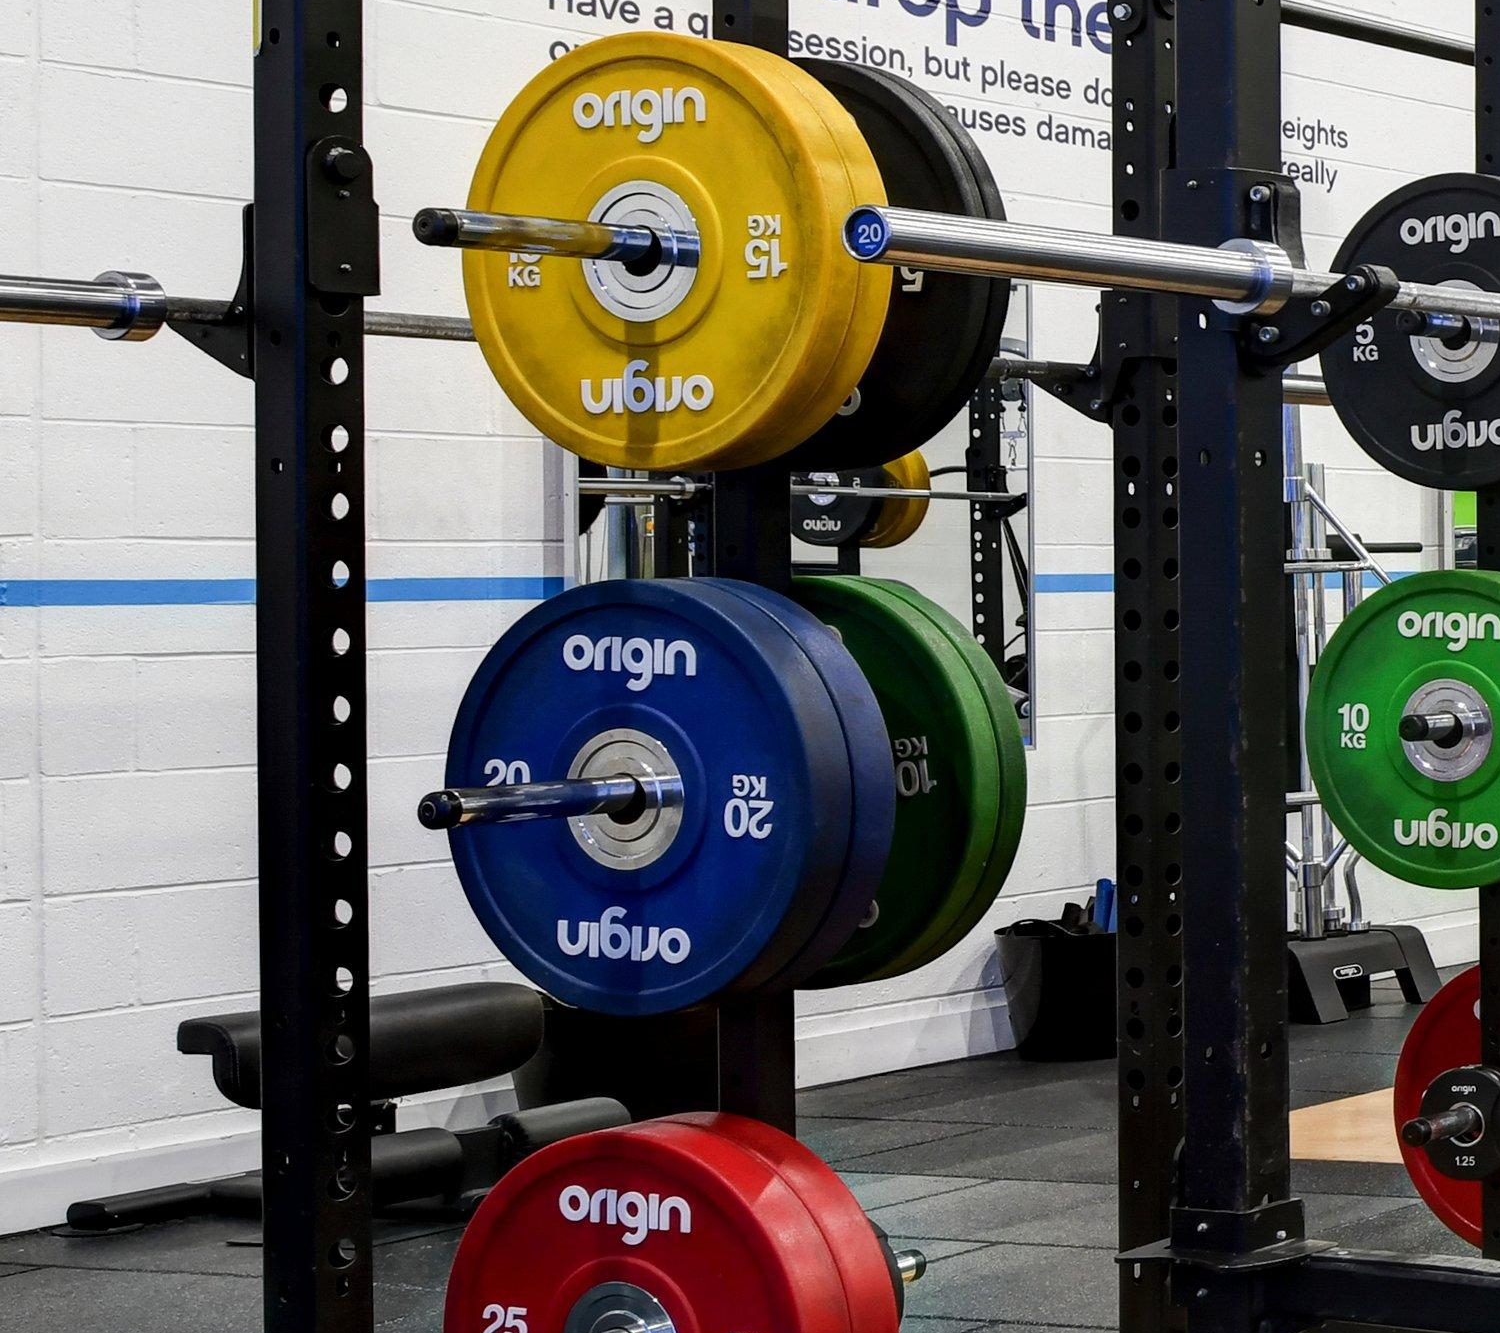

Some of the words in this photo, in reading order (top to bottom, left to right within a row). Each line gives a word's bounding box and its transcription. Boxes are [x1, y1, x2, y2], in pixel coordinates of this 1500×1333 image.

[654, 6, 674, 30] a
[788, 29, 914, 78] session,
[924, 46, 970, 83] but
[981, 60, 1072, 100] please
[1281, 117, 1348, 150] eights
[572, 86, 707, 144] origin
[945, 104, 1026, 136] auses
[1037, 113, 1112, 151] dama
[747, 215, 781, 236] KG
[858, 223, 882, 244] 20
[508, 266, 541, 288] KG
[745, 238, 788, 279] 15
[1353, 345, 1379, 362] KG
[580, 359, 714, 414] origin
[1397, 610, 1500, 651] origin
[563, 634, 696, 691] origin
[1337, 703, 1370, 730] 10
[1340, 731, 1366, 749] KG
[732, 775, 766, 799] KG
[724, 799, 773, 839] 20
[1394, 808, 1498, 849] origin
[556, 905, 690, 963] origin
[1451, 1085, 1476, 1094] origin
[559, 1184, 691, 1245] origin
